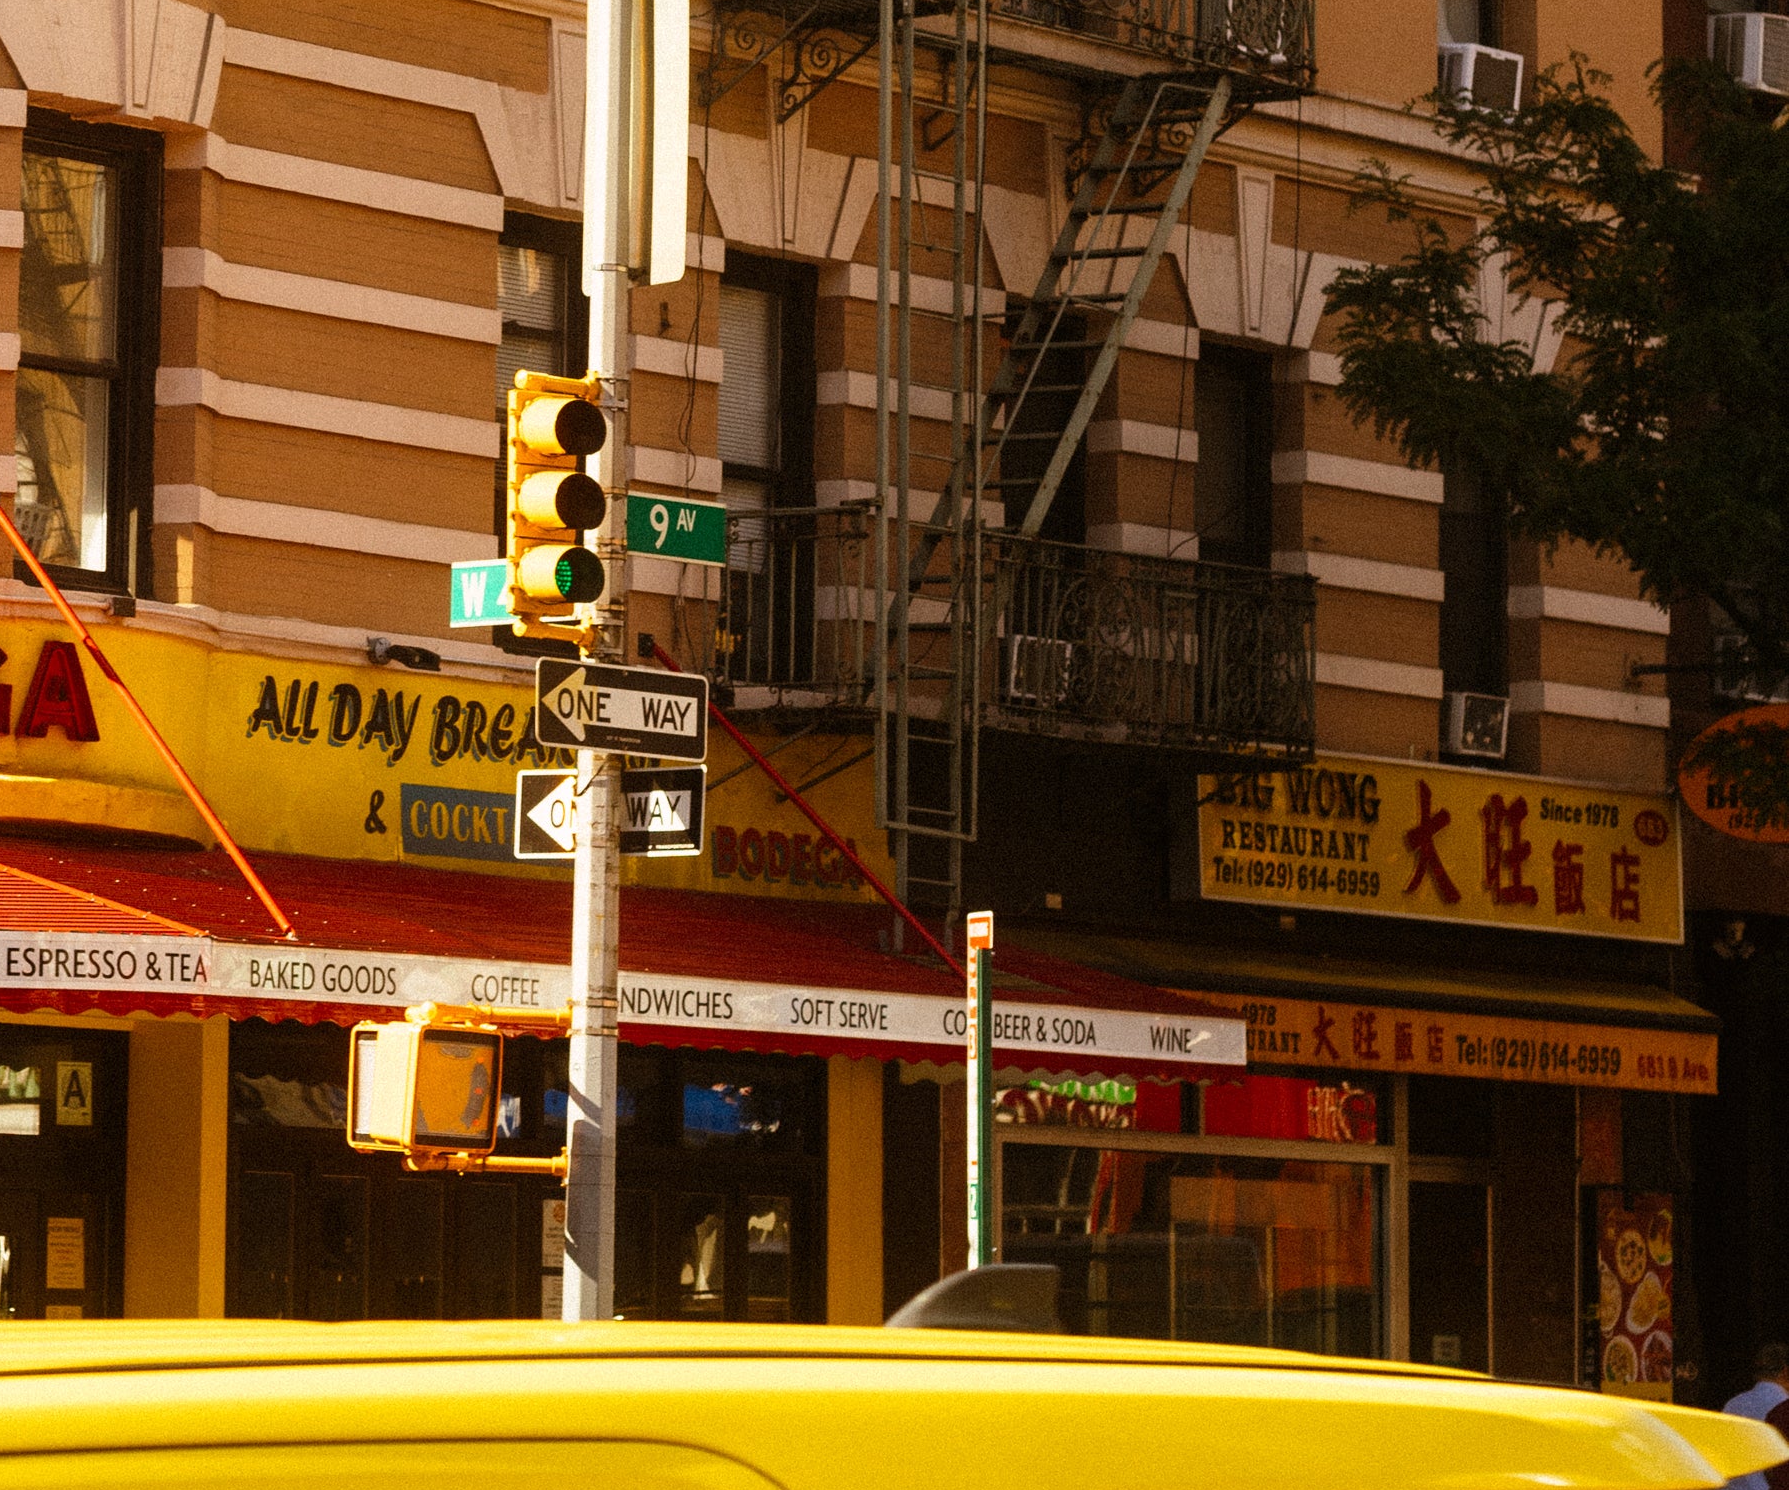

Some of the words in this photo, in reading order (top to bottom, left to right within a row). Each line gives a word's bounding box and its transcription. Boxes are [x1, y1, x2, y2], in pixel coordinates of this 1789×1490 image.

[649, 504, 670, 550] 9
[676, 509, 697, 532] AV
[461, 571, 487, 618] W
[251, 675, 319, 739] ALL
[330, 682, 421, 762] DAY
[557, 687, 612, 724] ONE
[641, 696, 692, 733] WAY
[624, 793, 682, 828] WAY
[1284, 769, 1382, 824] WONG
[1540, 797, 1581, 826] Since
[1585, 803, 1619, 830] 1978
[364, 790, 388, 835] &
[410, 799, 509, 846] COCKT
[715, 825, 867, 889] BODEGA
[1222, 819, 1371, 863] RESTAURANT
[1213, 857, 1245, 886] Tel:
[1247, 859, 1293, 893] (929)
[1297, 864, 1381, 897] 614-6959
[5, 947, 136, 980] ESPRESSO
[146, 952, 163, 981] &
[165, 952, 208, 983] TEA
[250, 959, 315, 991] BAKED
[321, 963, 397, 996] GOODS
[471, 974, 540, 1007] COFFEE
[620, 986, 734, 1020] NDWICHES
[790, 996, 835, 1029] SOFT
[839, 999, 889, 1032] SERVE
[943, 1008, 968, 1036] CO
[993, 1012, 1032, 1041] BEER
[1036, 1016, 1048, 1042] &
[1052, 1018, 1098, 1048] SODA
[1149, 1024, 1193, 1055] WINE
[1247, 1028, 1301, 1054] URANT
[62, 1069, 87, 1109] A
